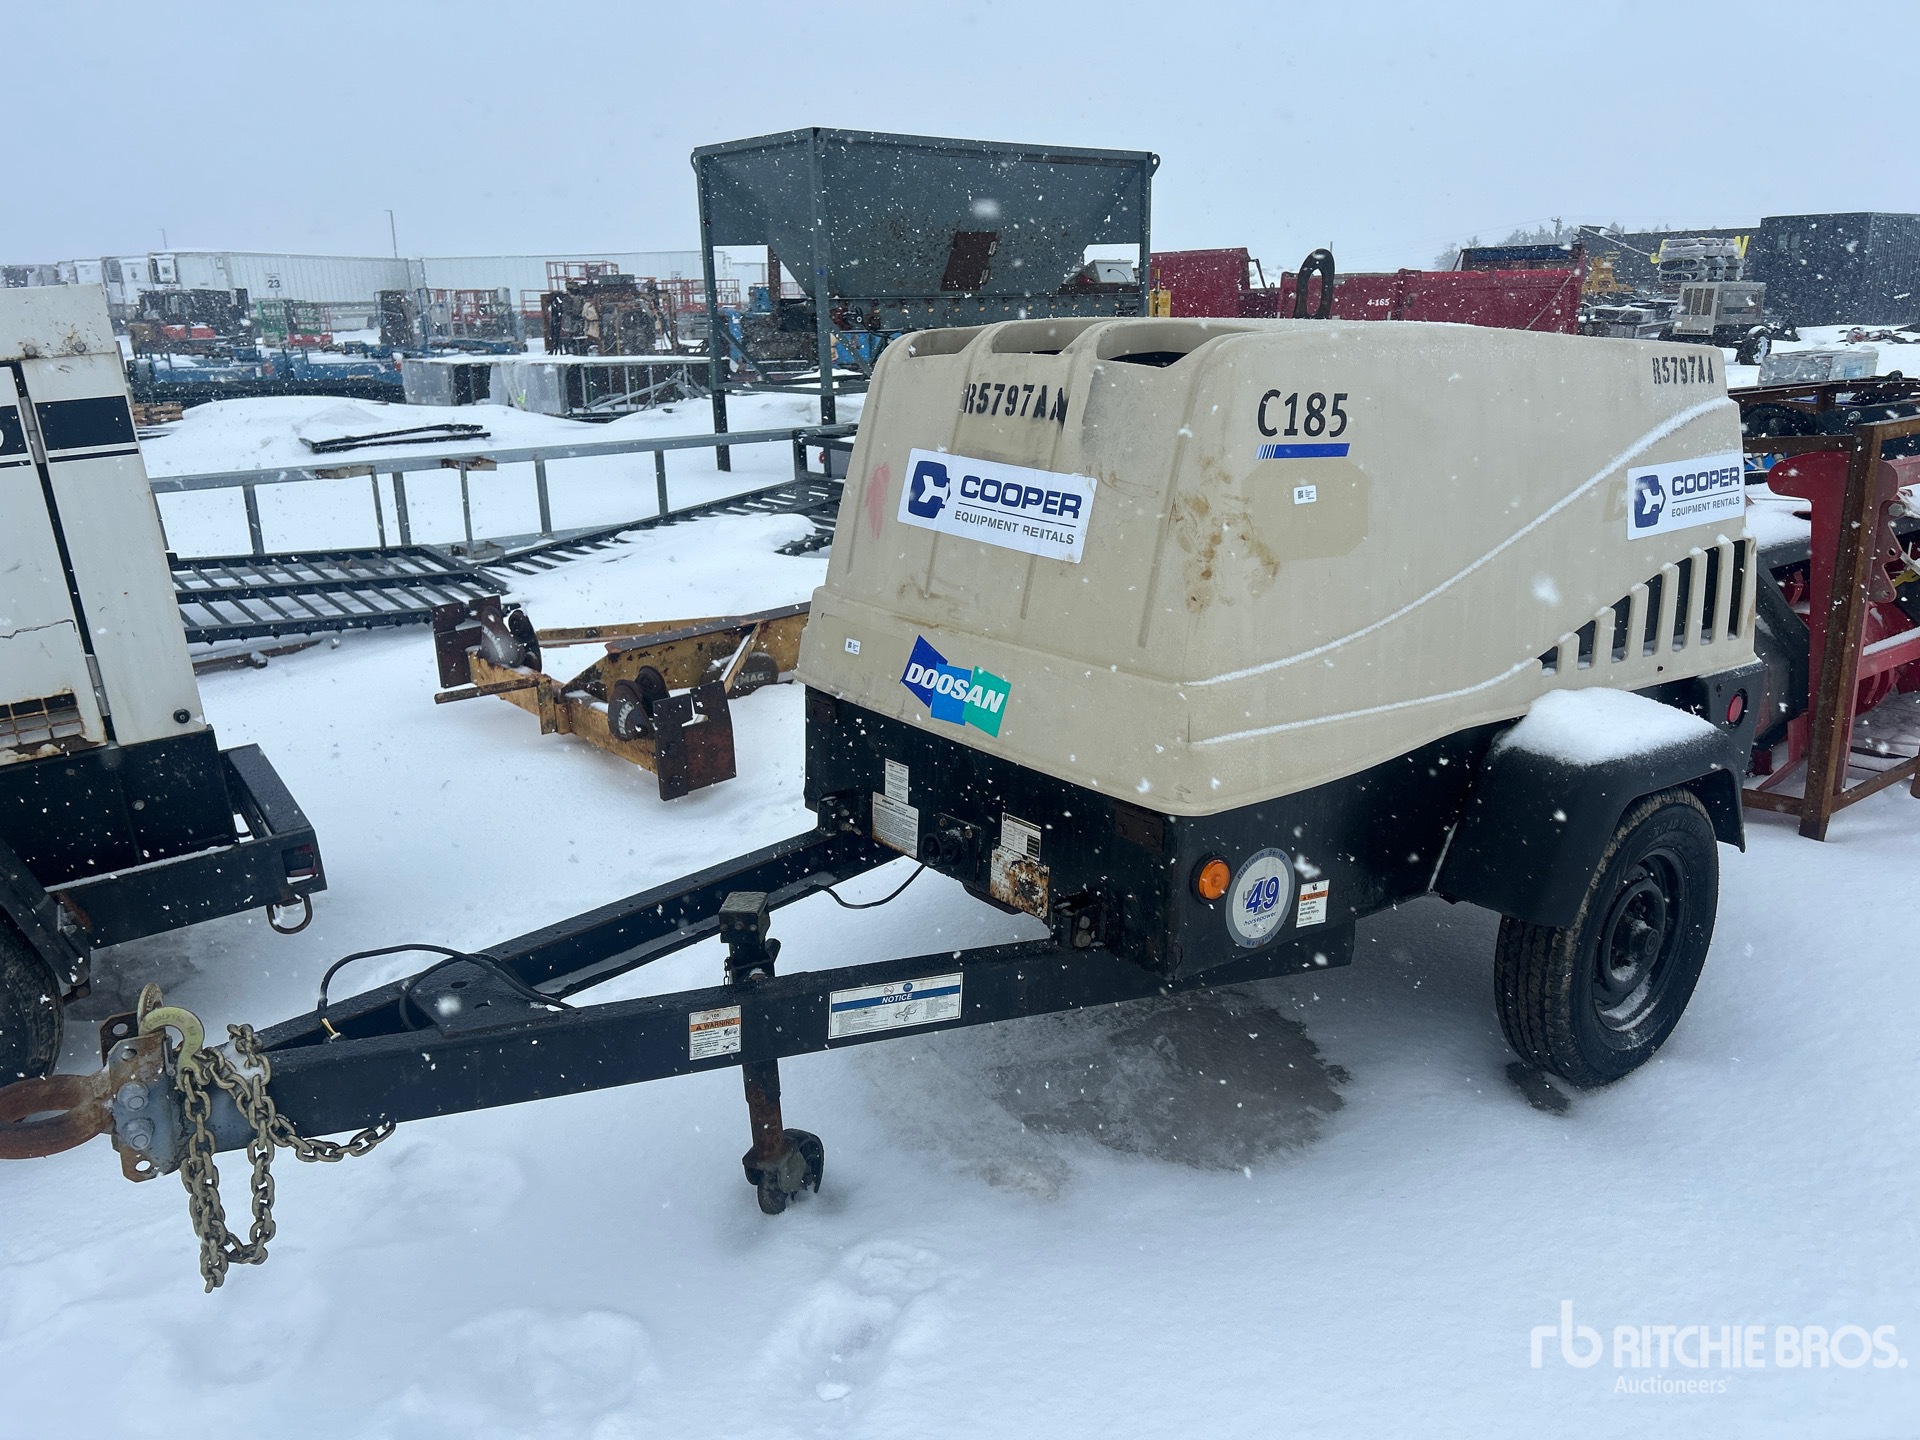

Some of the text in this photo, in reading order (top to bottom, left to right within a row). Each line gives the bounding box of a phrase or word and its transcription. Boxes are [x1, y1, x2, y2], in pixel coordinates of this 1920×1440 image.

[267, 279, 280, 288] 23
[1652, 355, 1714, 384] R5797AA
[963, 383, 1068, 423] R5797AA
[1258, 389, 1348, 437] C185
[1672, 466, 1740, 496] COOPER
[960, 475, 1082, 519] COOPER
[1671, 496, 1740, 518] EQUIPMENT RENTALS
[954, 510, 1019, 533] EQUIPMENT
[905, 662, 1005, 713] DOOSAN
[1237, 849, 1286, 880] Platinum Series
[1246, 876, 1280, 913] 49
[1243, 911, 1276, 926] horsepower
[882, 993, 913, 1004] NOTICE
[704, 1019, 735, 1029] WARNING
